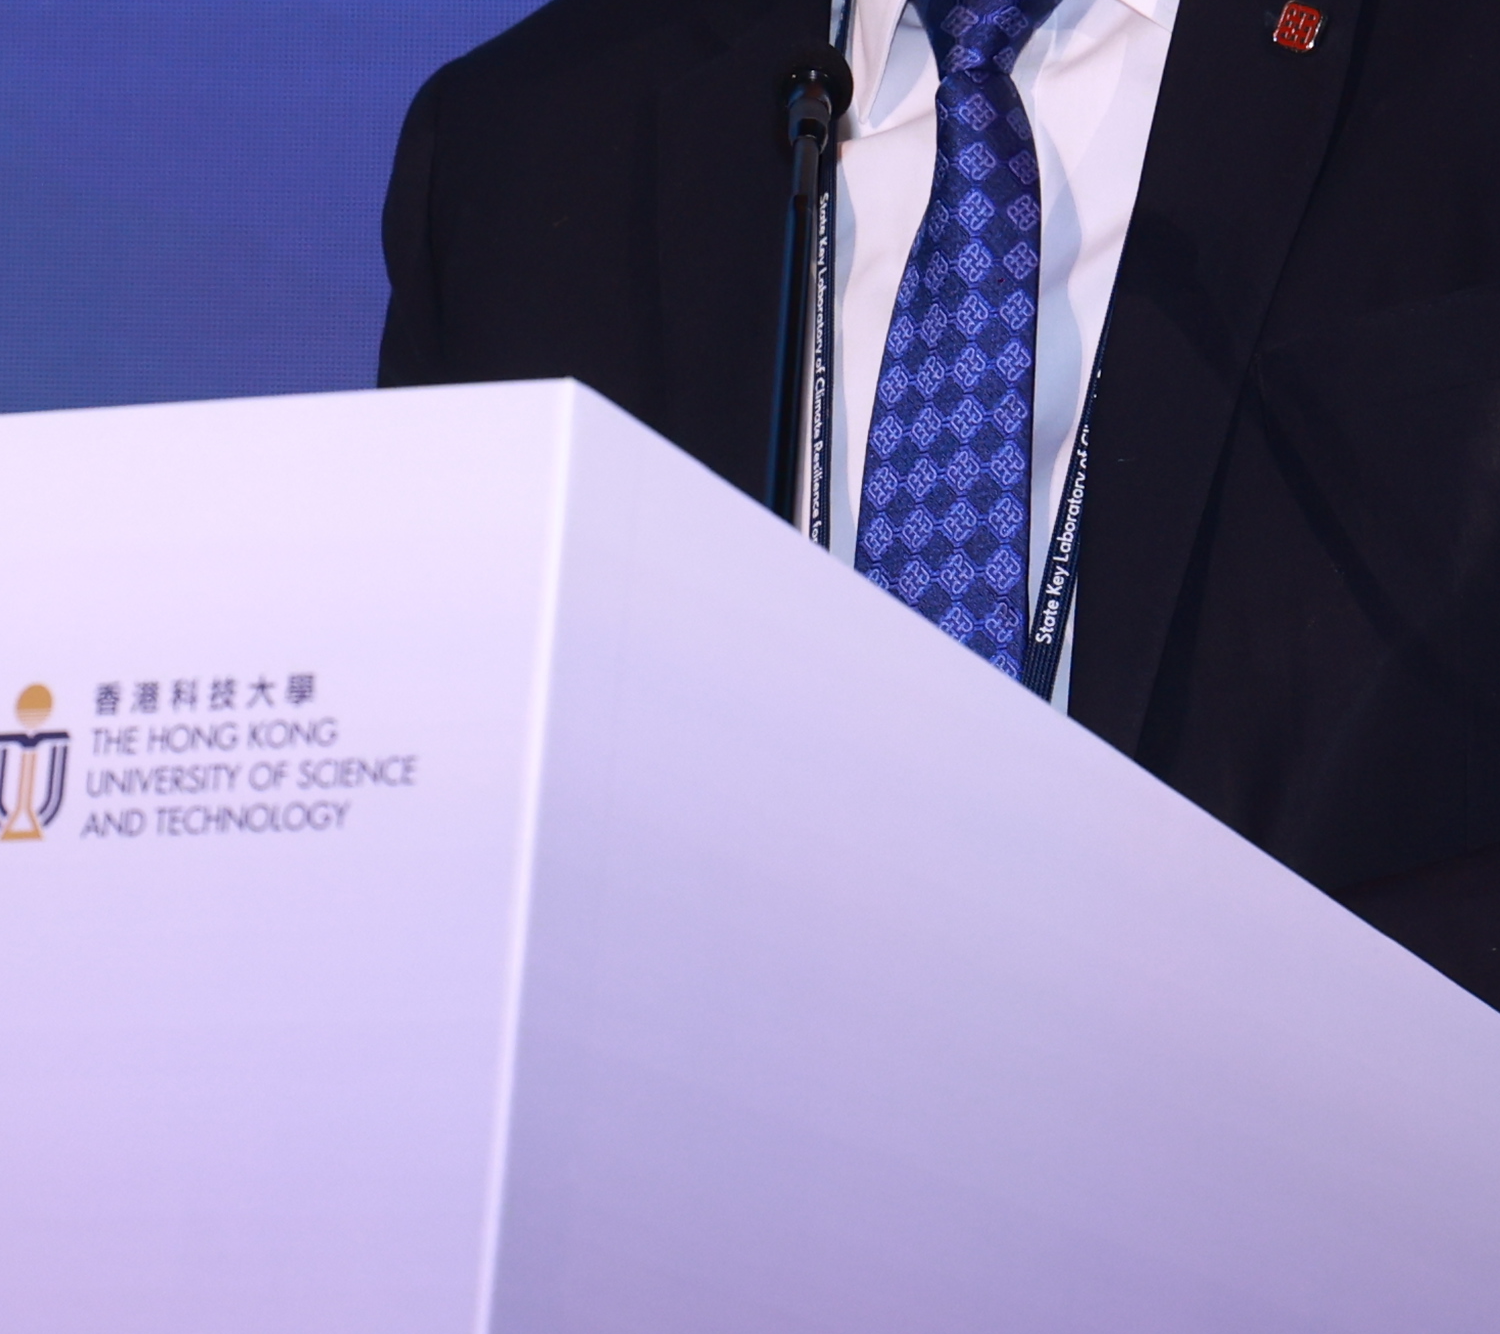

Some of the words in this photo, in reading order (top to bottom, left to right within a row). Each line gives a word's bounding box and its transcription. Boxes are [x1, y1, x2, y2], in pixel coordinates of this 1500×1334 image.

[819, 192, 829, 235] State
[815, 267, 827, 353] Laboratory
[813, 377, 825, 440] Climate
[812, 440, 824, 519] Resilience
[1053, 472, 1086, 562] Laboratory
[1046, 565, 1070, 596] Key
[1035, 598, 1059, 645] State
[94, 672, 317, 715] 香港科技大學
[91, 726, 139, 756] THE
[147, 722, 238, 754] HONG
[247, 717, 339, 749] KONG
[86, 764, 243, 798] UNIVERSITY
[248, 761, 288, 791] OF
[297, 755, 419, 789] SCIENCE
[80, 808, 147, 839] AND
[156, 800, 351, 836] TECHNOLOGY
